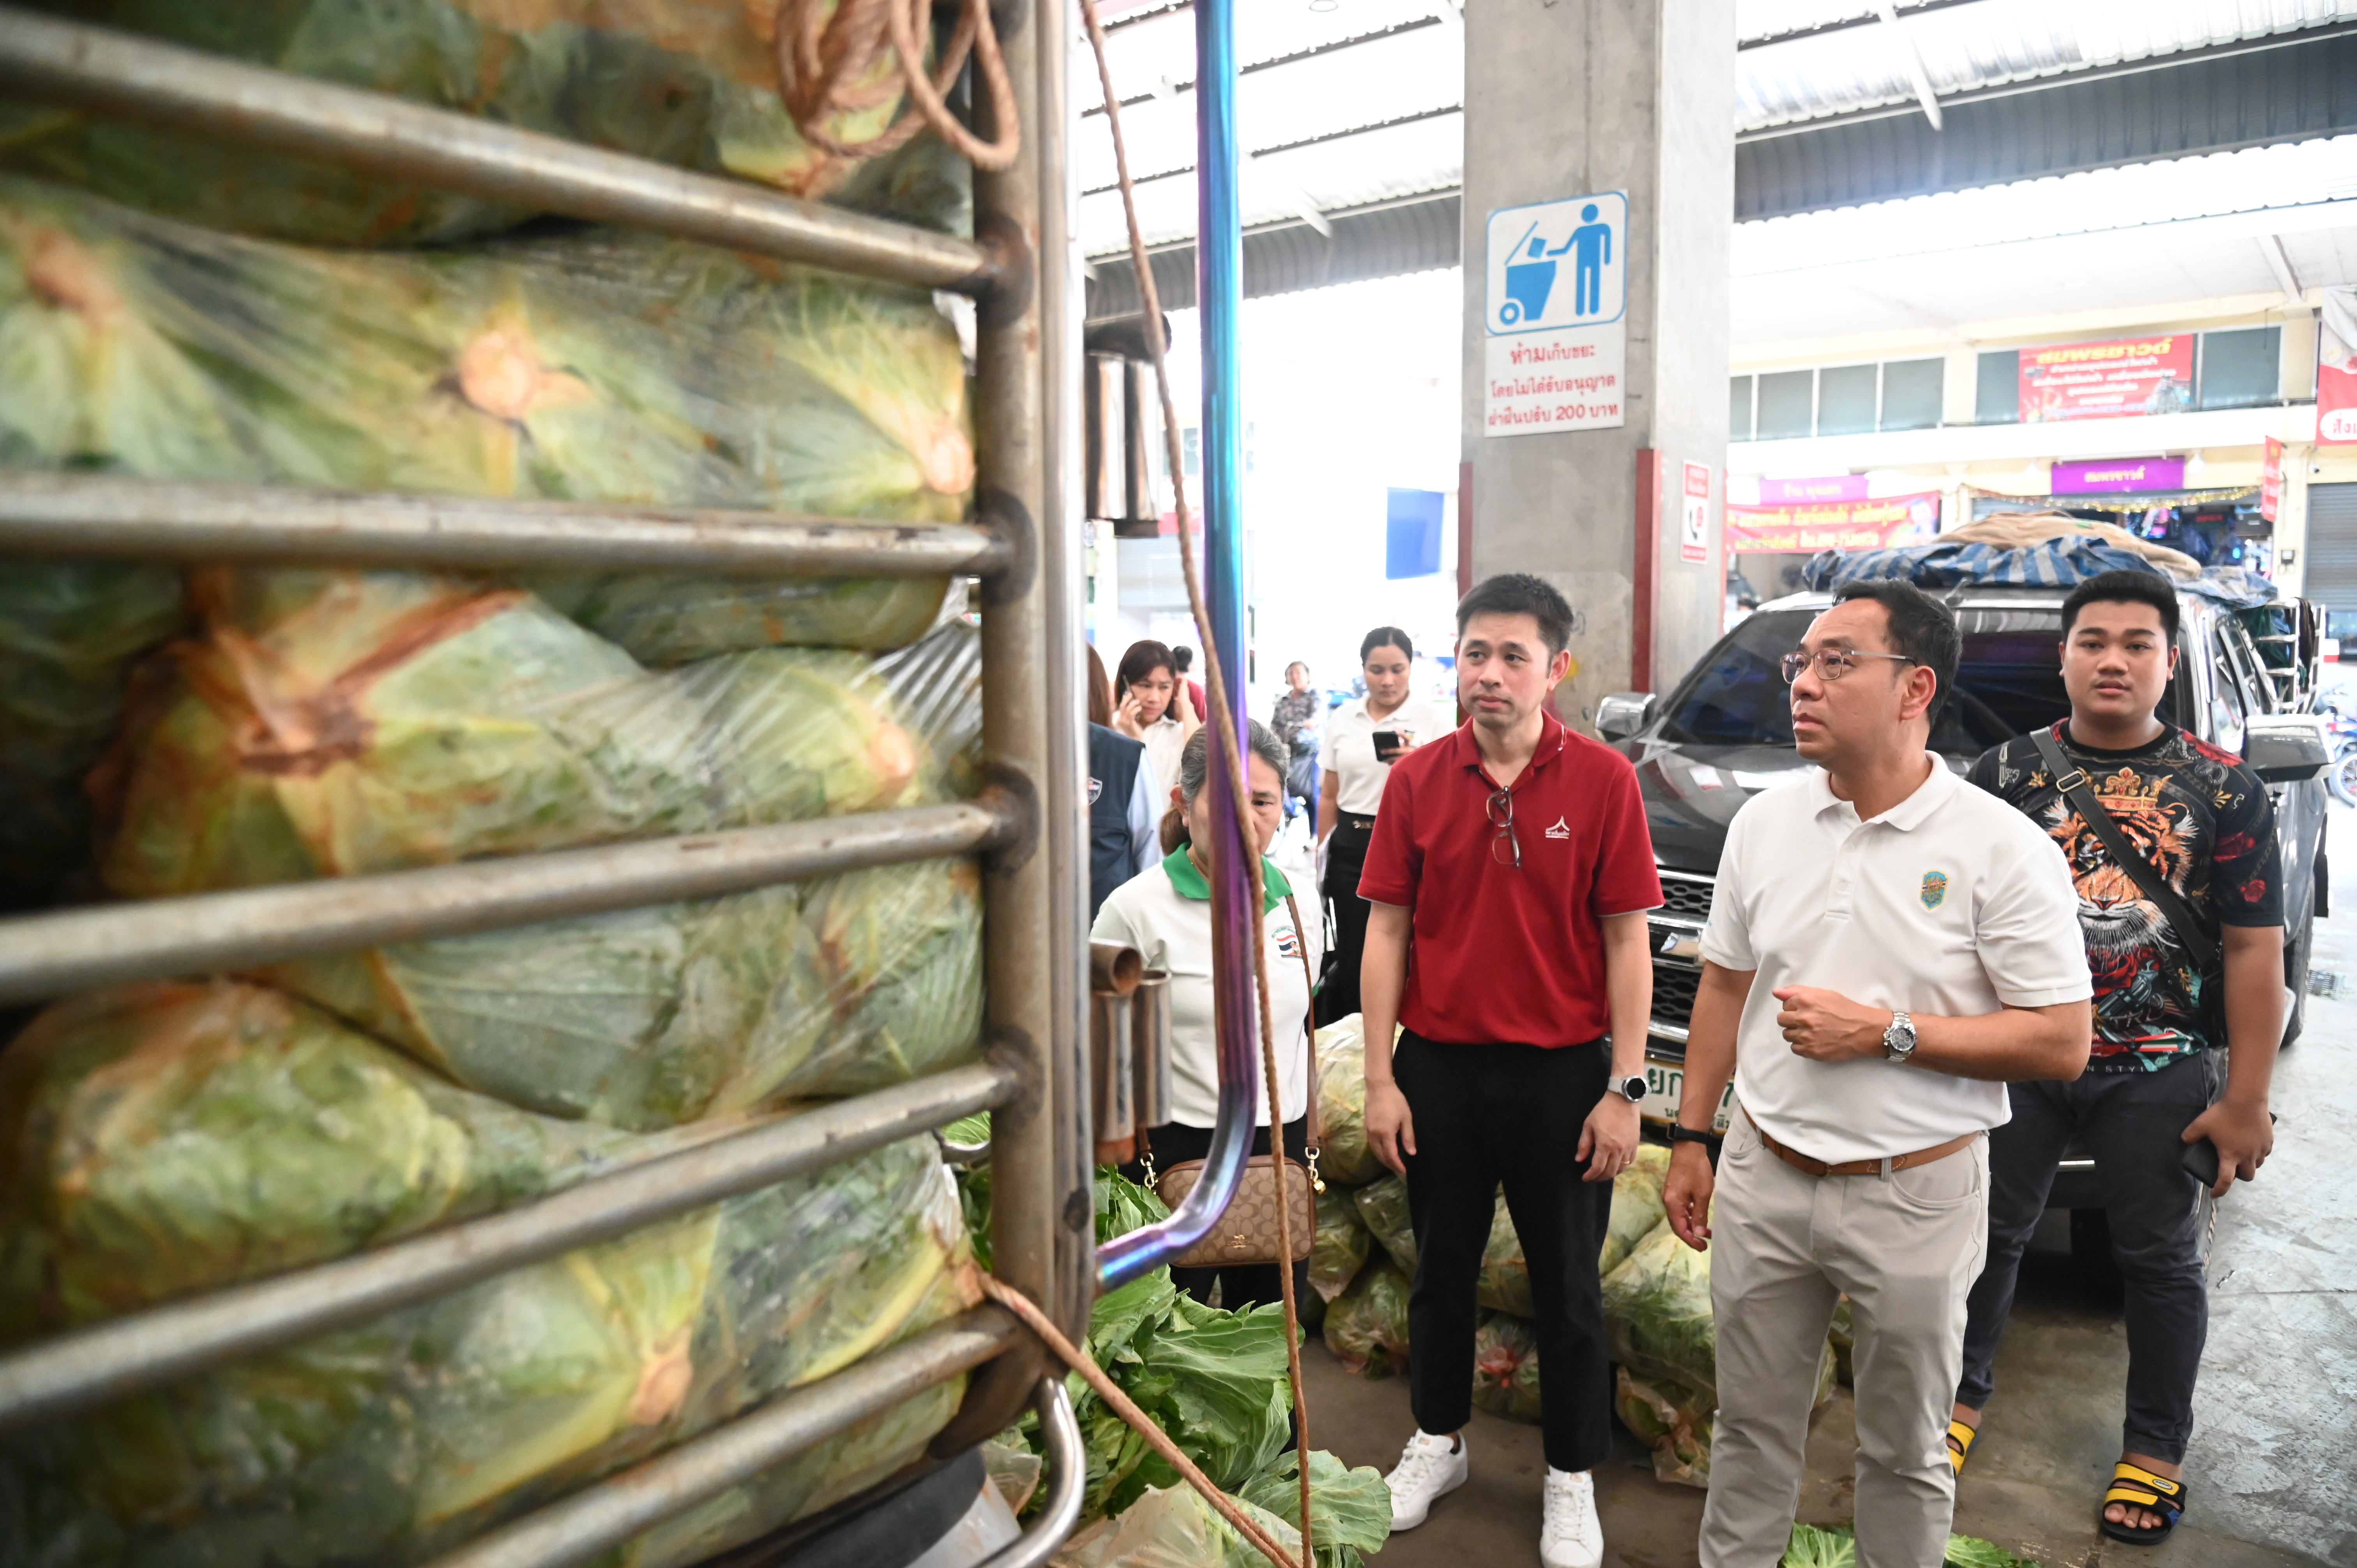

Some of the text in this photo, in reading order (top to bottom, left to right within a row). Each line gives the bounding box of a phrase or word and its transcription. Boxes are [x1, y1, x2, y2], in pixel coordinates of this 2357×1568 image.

[1510, 342, 1596, 365] ห้ามเก็บขยะ
[1491, 375, 1615, 397] โดยไม่ได้รับอนุญาต
[1557, 404, 1585, 420] 200
[1589, 404, 1618, 418] บาท
